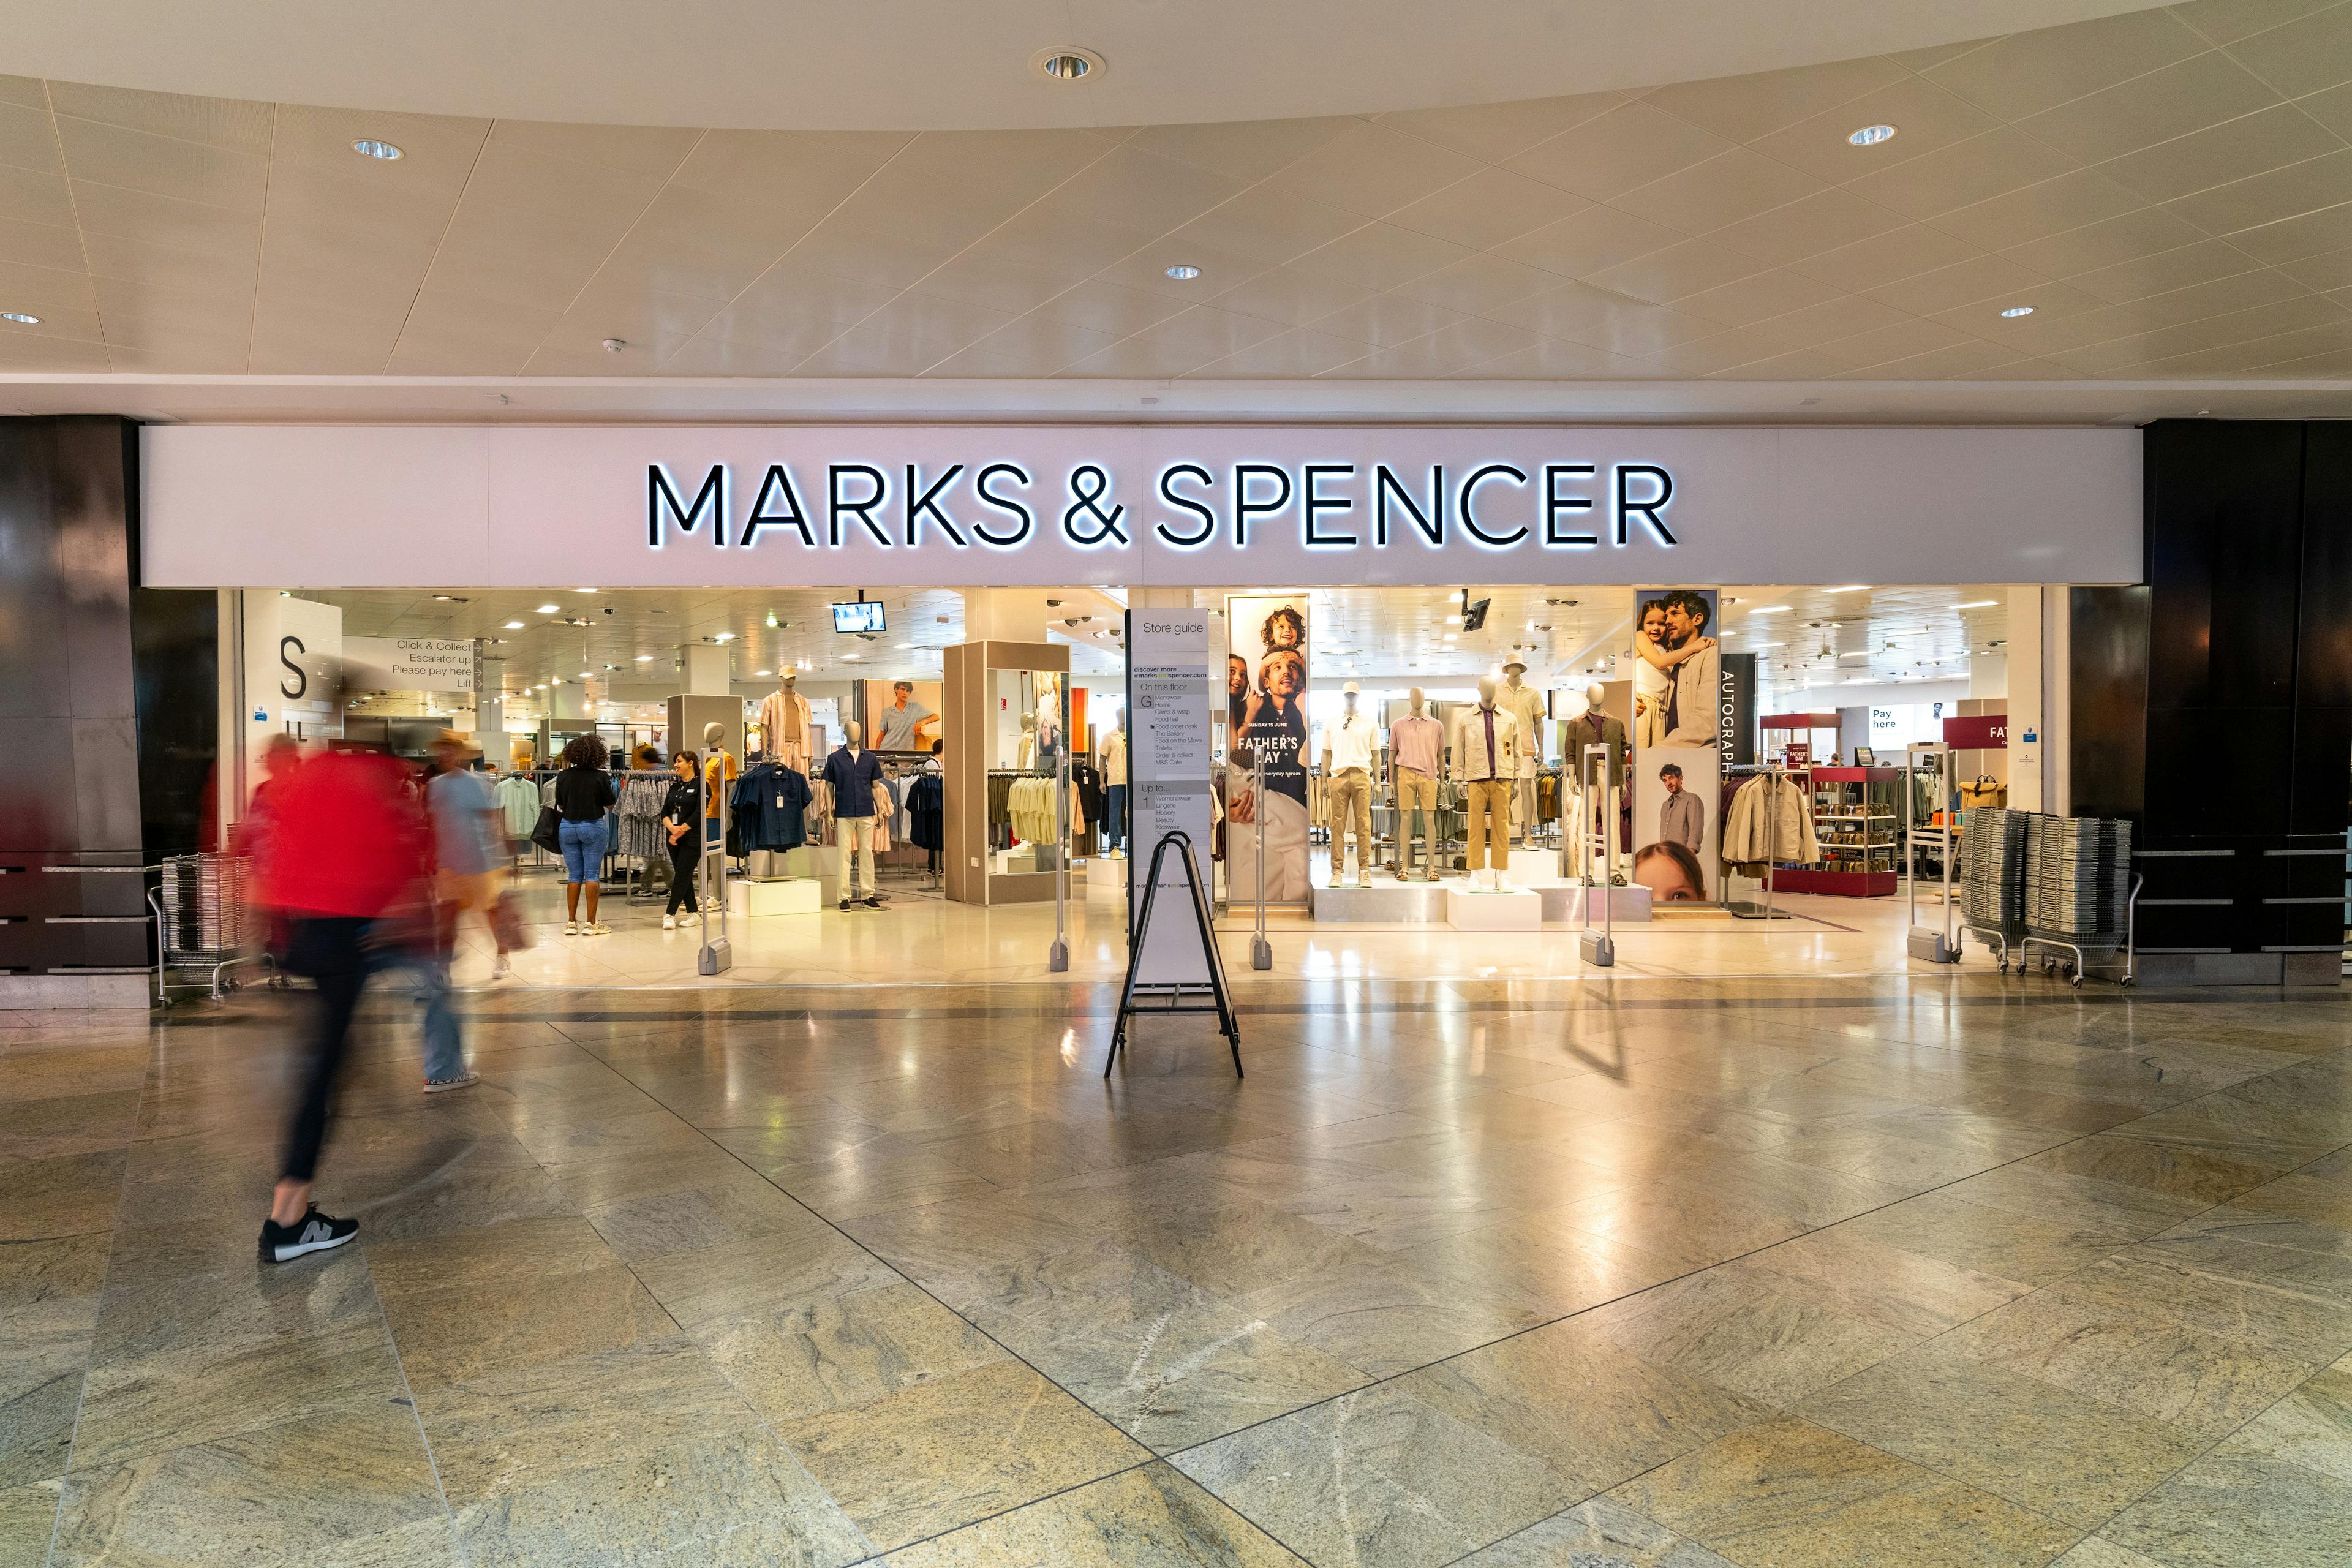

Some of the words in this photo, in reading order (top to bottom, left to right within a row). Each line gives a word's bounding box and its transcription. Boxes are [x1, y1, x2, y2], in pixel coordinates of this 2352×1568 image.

[648, 463, 1031, 546] MARKS
[1063, 464, 1129, 546] &
[1156, 463, 1678, 546] SPENCER
[1143, 622, 1171, 633] Store
[1174, 622, 1204, 635] guide
[397, 640, 423, 650] Click
[426, 641, 433, 650] &
[436, 642, 471, 652] Collect
[410, 653, 456, 663] Escalator
[393, 665, 426, 674] Please
[429, 668, 447, 677] pay
[450, 667, 471, 676] here
[457, 679, 472, 688] Lift
[1140, 695, 1152, 708] G
[1873, 710, 1891, 719] Pay
[1721, 670, 1735, 773] AUTOGRAPH
[1256, 751, 1281, 763] AY
[1142, 785, 1153, 793] Up
[1143, 797, 1148, 809] 1
